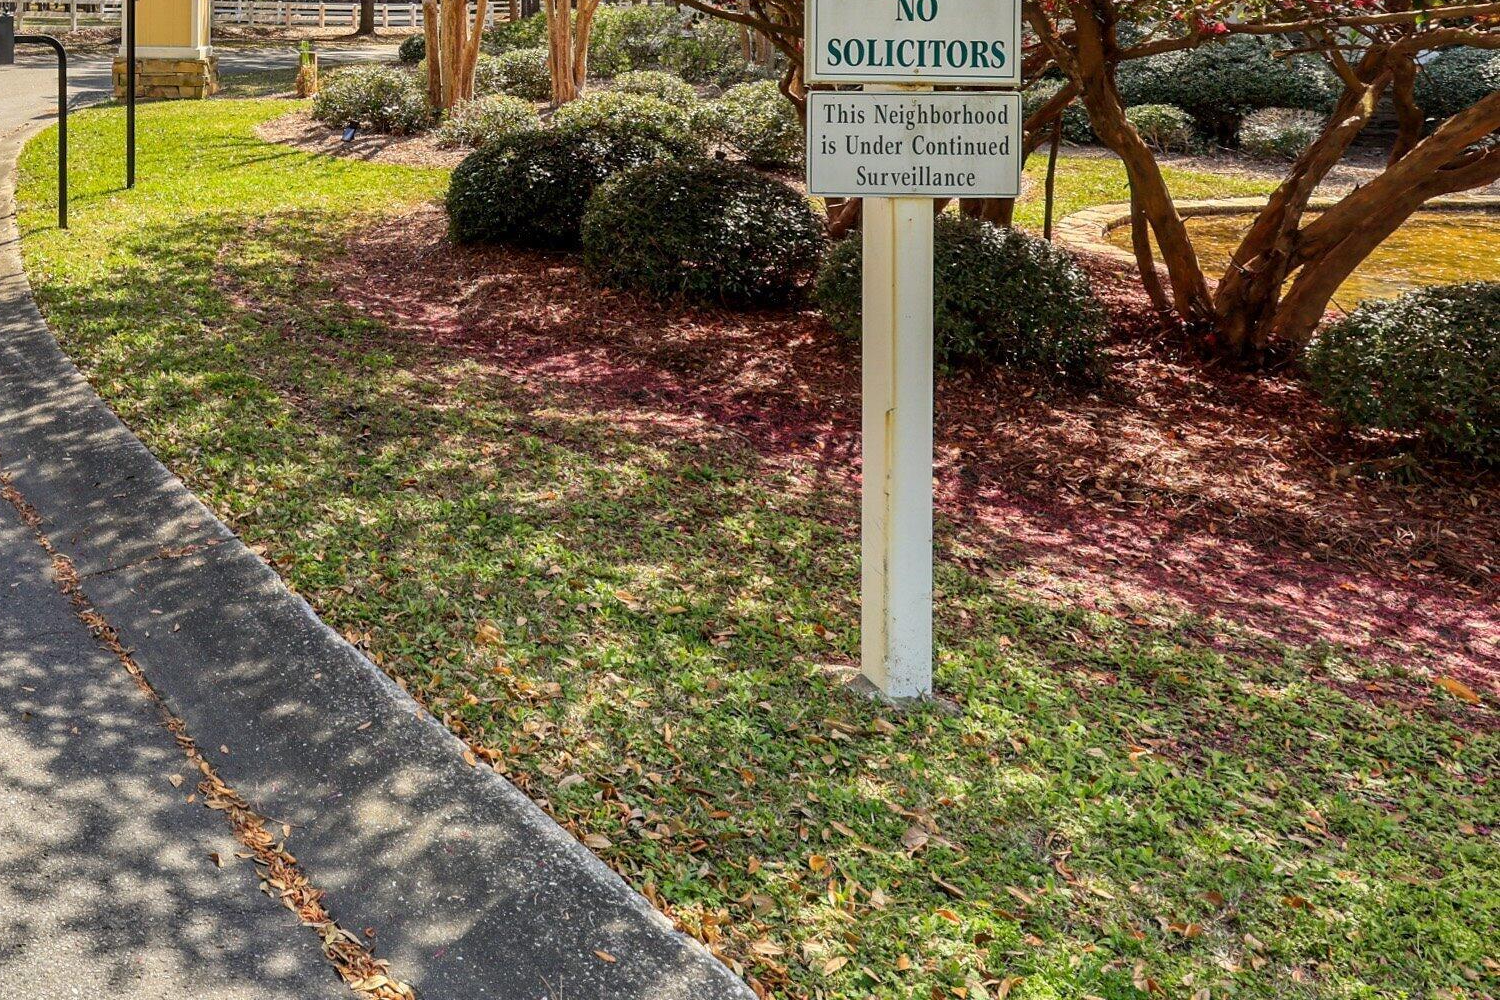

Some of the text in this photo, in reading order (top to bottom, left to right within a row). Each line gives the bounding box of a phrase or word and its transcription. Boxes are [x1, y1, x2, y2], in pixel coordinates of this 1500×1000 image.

[827, 38, 1006, 69] SOLICITORS
[823, 103, 1009, 130] This Neighborhood
[821, 135, 1010, 156] is Under Continued
[856, 166, 976, 187] Surveillance
